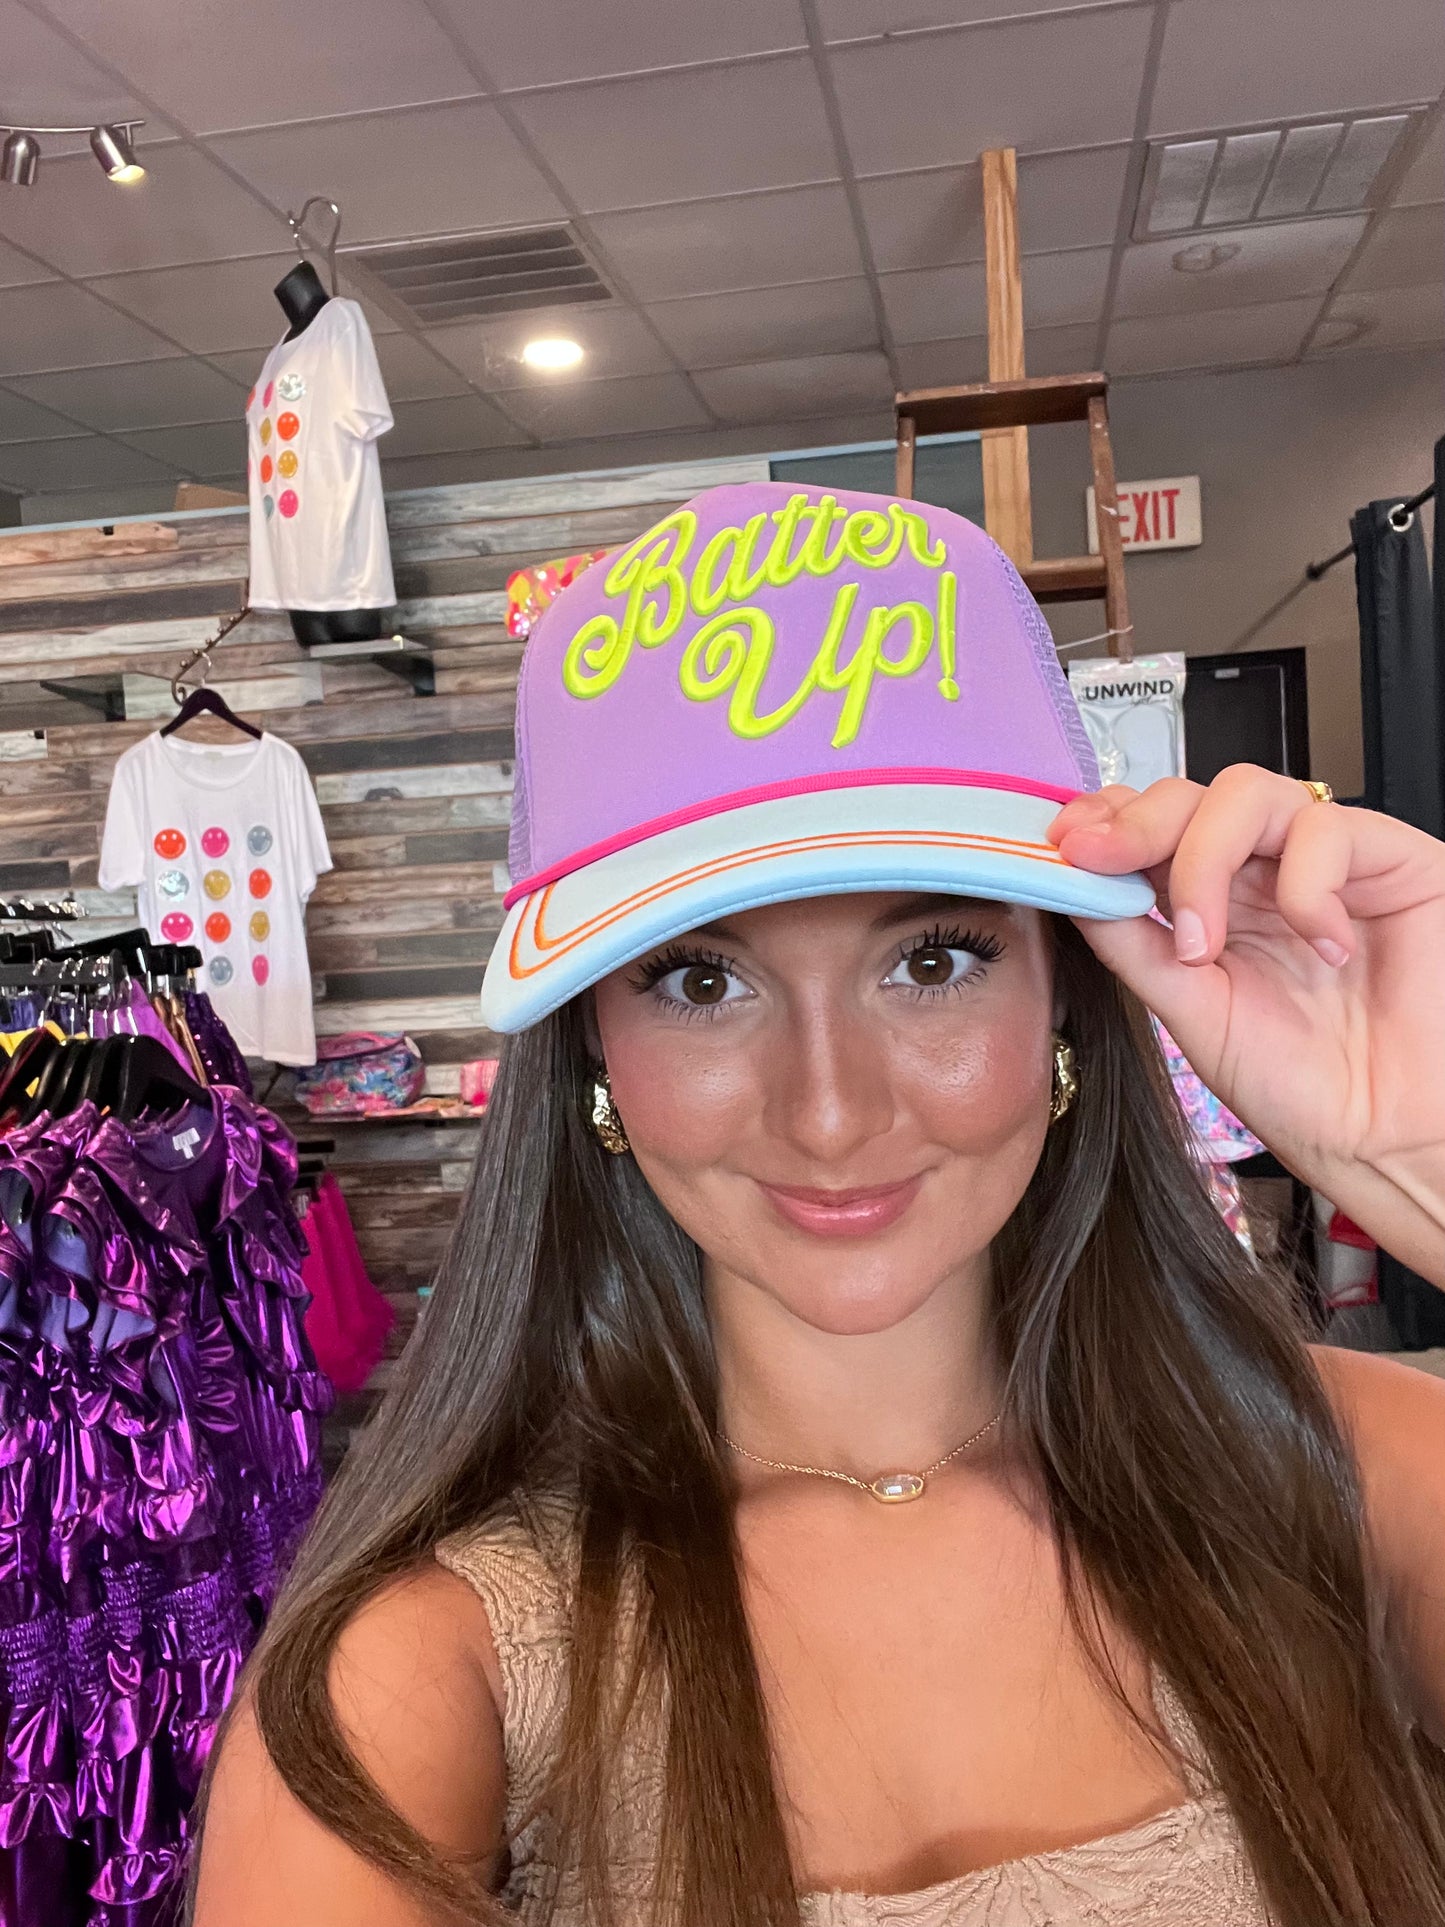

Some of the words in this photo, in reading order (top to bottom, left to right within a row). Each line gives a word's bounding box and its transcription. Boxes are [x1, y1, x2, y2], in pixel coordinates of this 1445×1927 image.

[563, 494, 946, 700] Batter
[679, 571, 960, 748] Up!
[1085, 680, 1174, 700] UNWIND
